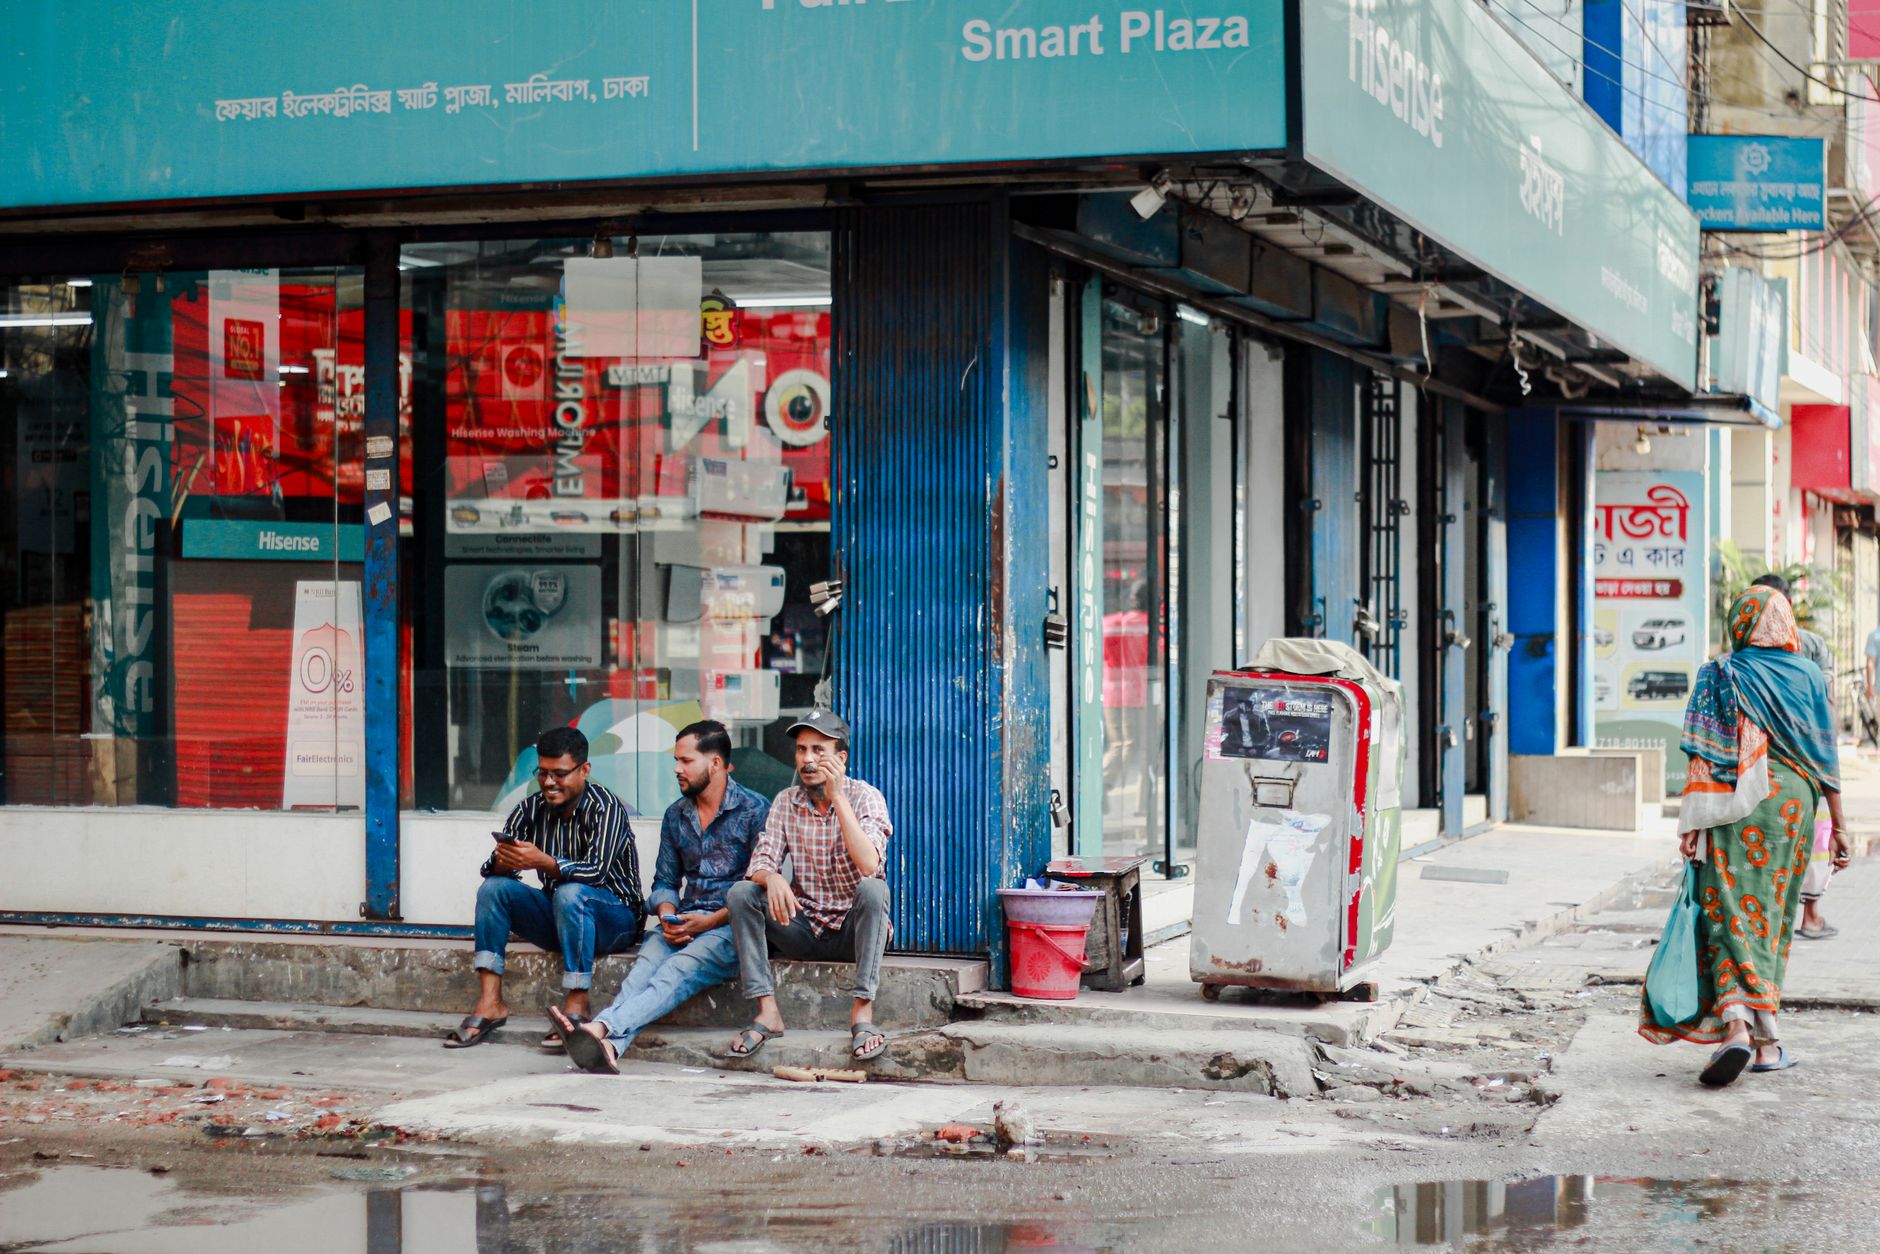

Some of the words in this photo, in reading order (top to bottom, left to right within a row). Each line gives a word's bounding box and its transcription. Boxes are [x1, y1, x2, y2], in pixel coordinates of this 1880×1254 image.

[960, 14, 1104, 62] Smart
[1120, 10, 1250, 54] Plaza
[215, 97, 277, 121] ফেয়ার
[397, 82, 438, 110] স্মার্ট
[504, 73, 597, 105] মালিবাগ,
[602, 75, 650, 100] ঢাকা
[1349, 0, 1442, 148] Hisense
[1735, 205, 1790, 224] Available
[1792, 207, 1820, 224] Here
[451, 428, 495, 438] Hisense
[497, 428, 545, 440] Washing
[124, 363, 172, 713] Hisense
[258, 531, 320, 552] Hisense
[1083, 452, 1097, 704] Hisense
[300, 647, 354, 694] 0%
[507, 643, 539, 653] Steam
